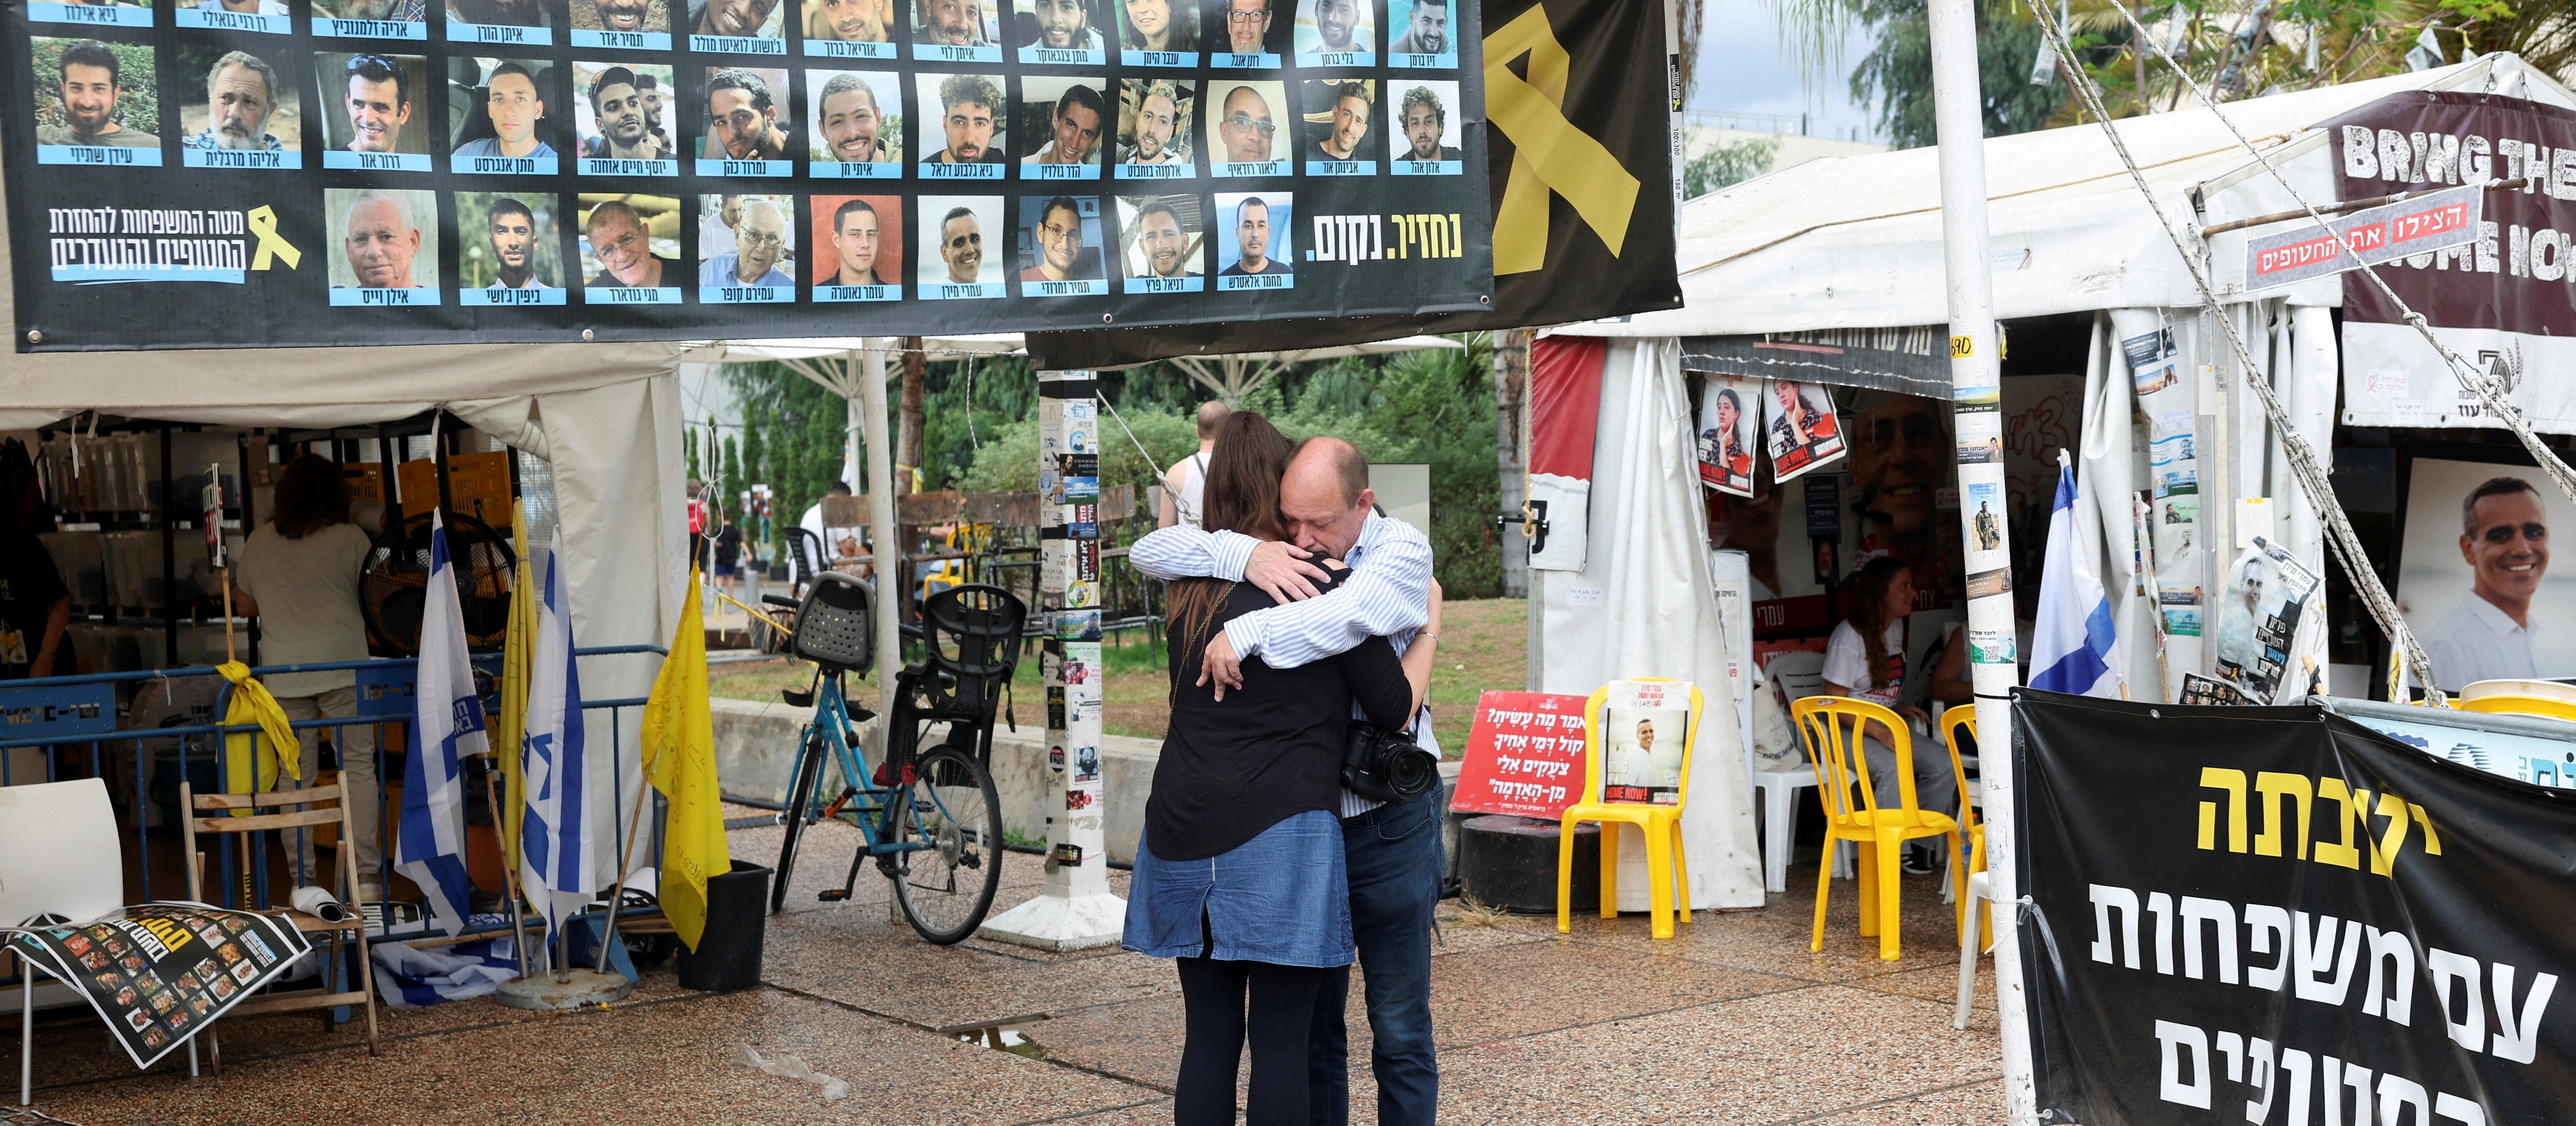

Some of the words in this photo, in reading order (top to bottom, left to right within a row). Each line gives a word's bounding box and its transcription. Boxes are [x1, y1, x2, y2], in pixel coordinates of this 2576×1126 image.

[64, 6, 95, 21] אילוז
[98, 8, 117, 22] גיא
[203, 12, 236, 27] גואילי
[239, 15, 254, 29] רני
[256, 17, 266, 31] רן
[332, 20, 378, 36] זלמנוביץ
[382, 23, 407, 37] אריה
[478, 26, 497, 42] הורן
[501, 28, 522, 43] איתן
[600, 33, 617, 45] אדר
[620, 33, 643, 46] תמיר
[695, 37, 716, 51] מולל
[719, 39, 748, 52] לואיטו
[752, 40, 781, 53] ג'ושוע
[824, 43, 844, 56] ברוך
[846, 44, 876, 56] אוריאל
[941, 48, 952, 59] לוי
[956, 48, 975, 60] איתן
[1036, 48, 1071, 62] צנגאוקר
[1074, 50, 1088, 64] מתן
[1144, 53, 1159, 66] הימן
[1162, 53, 1178, 64] ענבר
[1341, 54, 1354, 65] גלי
[1231, 55, 1246, 66] אנגל
[1247, 55, 1259, 67] רונן
[1320, 54, 1338, 67] ברמן
[1410, 55, 1425, 67] ברמן
[1427, 56, 1435, 66] זיו
[71, 148, 104, 162] שתיוי
[108, 149, 132, 165] עידן
[206, 150, 244, 166] מרגלית
[248, 152, 279, 167] אליהו
[359, 154, 377, 167] אור
[2342, 125, 2492, 184] BRING
[379, 155, 400, 168] דרור
[474, 160, 514, 173] אנגרסט
[516, 160, 534, 174] מתן
[591, 160, 619, 173] אוחנה
[622, 161, 642, 174] חיים
[742, 162, 766, 174] נמרוד
[1323, 163, 1333, 173] אור
[1411, 163, 1423, 173] אהל
[646, 162, 666, 176] יוסף
[724, 162, 738, 176] כהן
[841, 164, 850, 177] חן
[853, 164, 872, 176] איתי
[931, 165, 952, 176] דלאל
[955, 165, 977, 177] גלבוע
[980, 165, 992, 177] גיא
[1042, 166, 1063, 179] גולדין
[1066, 166, 1080, 177] הדר
[1128, 165, 1154, 177] בוחבוט
[1156, 164, 1181, 178] אלקנה
[1228, 162, 1256, 177] רודאיף
[1258, 162, 1278, 175] ליאור
[1335, 163, 1358, 175] אבינתן
[1426, 163, 1439, 175] אלון
[49, 207, 116, 233] להחזרת
[122, 209, 205, 234] המשפחות
[209, 211, 244, 235] מטה
[2398, 206, 2461, 238] הצילו
[1306, 215, 1381, 266] נקום.
[1387, 214, 1462, 260] נחזיר.
[2350, 229, 2380, 248] את
[52, 237, 150, 271] והנעדרים
[157, 239, 247, 271] החטופים
[2262, 235, 2337, 272] החטופים
[1070, 282, 1090, 293] תמיר
[1146, 280, 1161, 293] פרץ
[1163, 279, 1183, 290] דניאל
[1229, 277, 1260, 288] אלאטרש
[1262, 276, 1281, 287] מחמד
[721, 288, 742, 302] קופר
[747, 288, 773, 300] עמירם
[832, 287, 861, 299] נאוטרה
[864, 287, 883, 299] עומר
[942, 286, 959, 298] מירן
[961, 286, 981, 297] עמרי
[1042, 282, 1067, 295] נמרודי
[362, 291, 382, 303] וייס
[386, 290, 408, 305] אילן
[487, 290, 512, 302] ג'ושי
[516, 290, 540, 305] ביפין
[610, 291, 641, 301] גודארד
[644, 290, 658, 301] מני
[2459, 405, 2480, 417] עוז
[2289, 576, 2308, 592] MIRAN
[2298, 570, 2312, 585] עמרי
[1757, 605, 1785, 626] עמרי
[1607, 761, 1628, 774] BRING
[1606, 787, 1623, 799] HOME
[1625, 788, 1647, 800] NOW!
[2090, 883, 2416, 1028] משפחות
[2428, 947, 2559, 1065] עם
